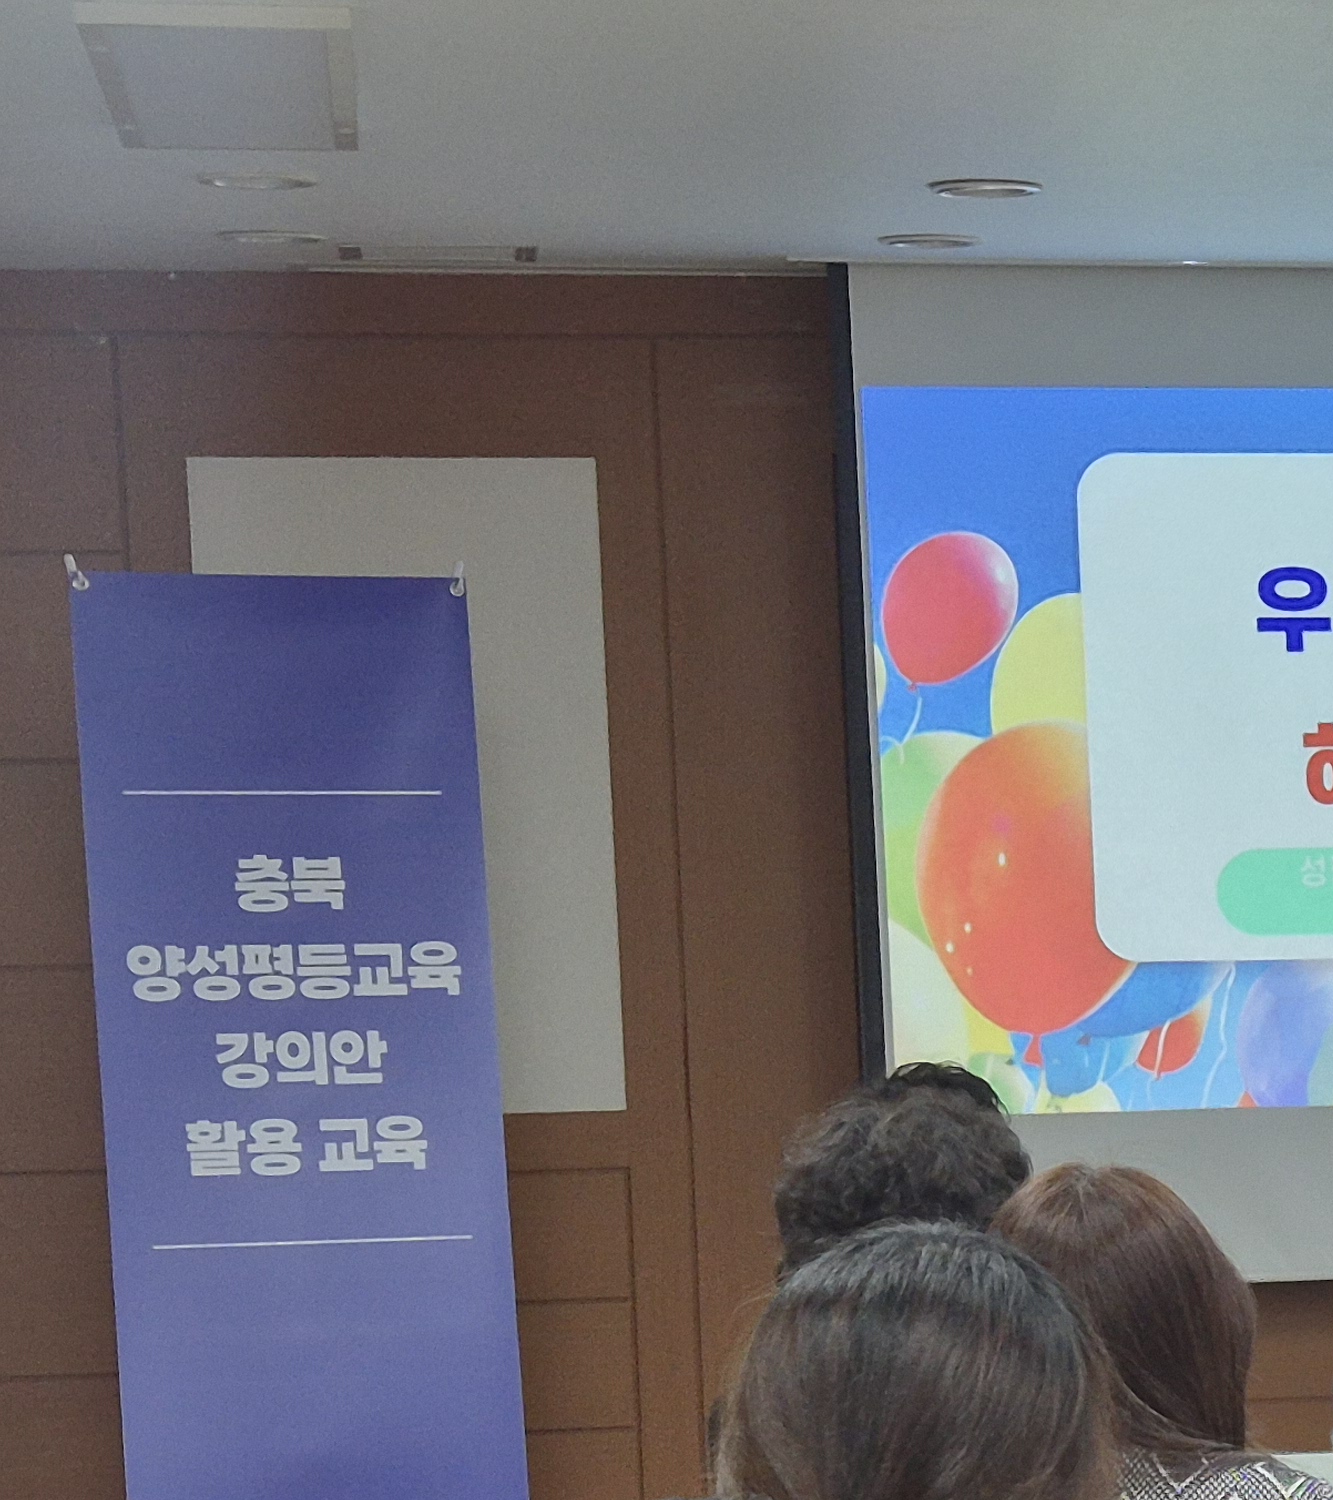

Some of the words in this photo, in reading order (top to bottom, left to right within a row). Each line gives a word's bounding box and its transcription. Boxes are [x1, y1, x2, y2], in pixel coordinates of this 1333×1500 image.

[235, 855, 345, 912] 충북
[126, 941, 461, 1001] 양성평등교육
[216, 1030, 388, 1088] 강의안
[186, 1119, 302, 1176] 활용
[318, 1115, 428, 1171] 교육
